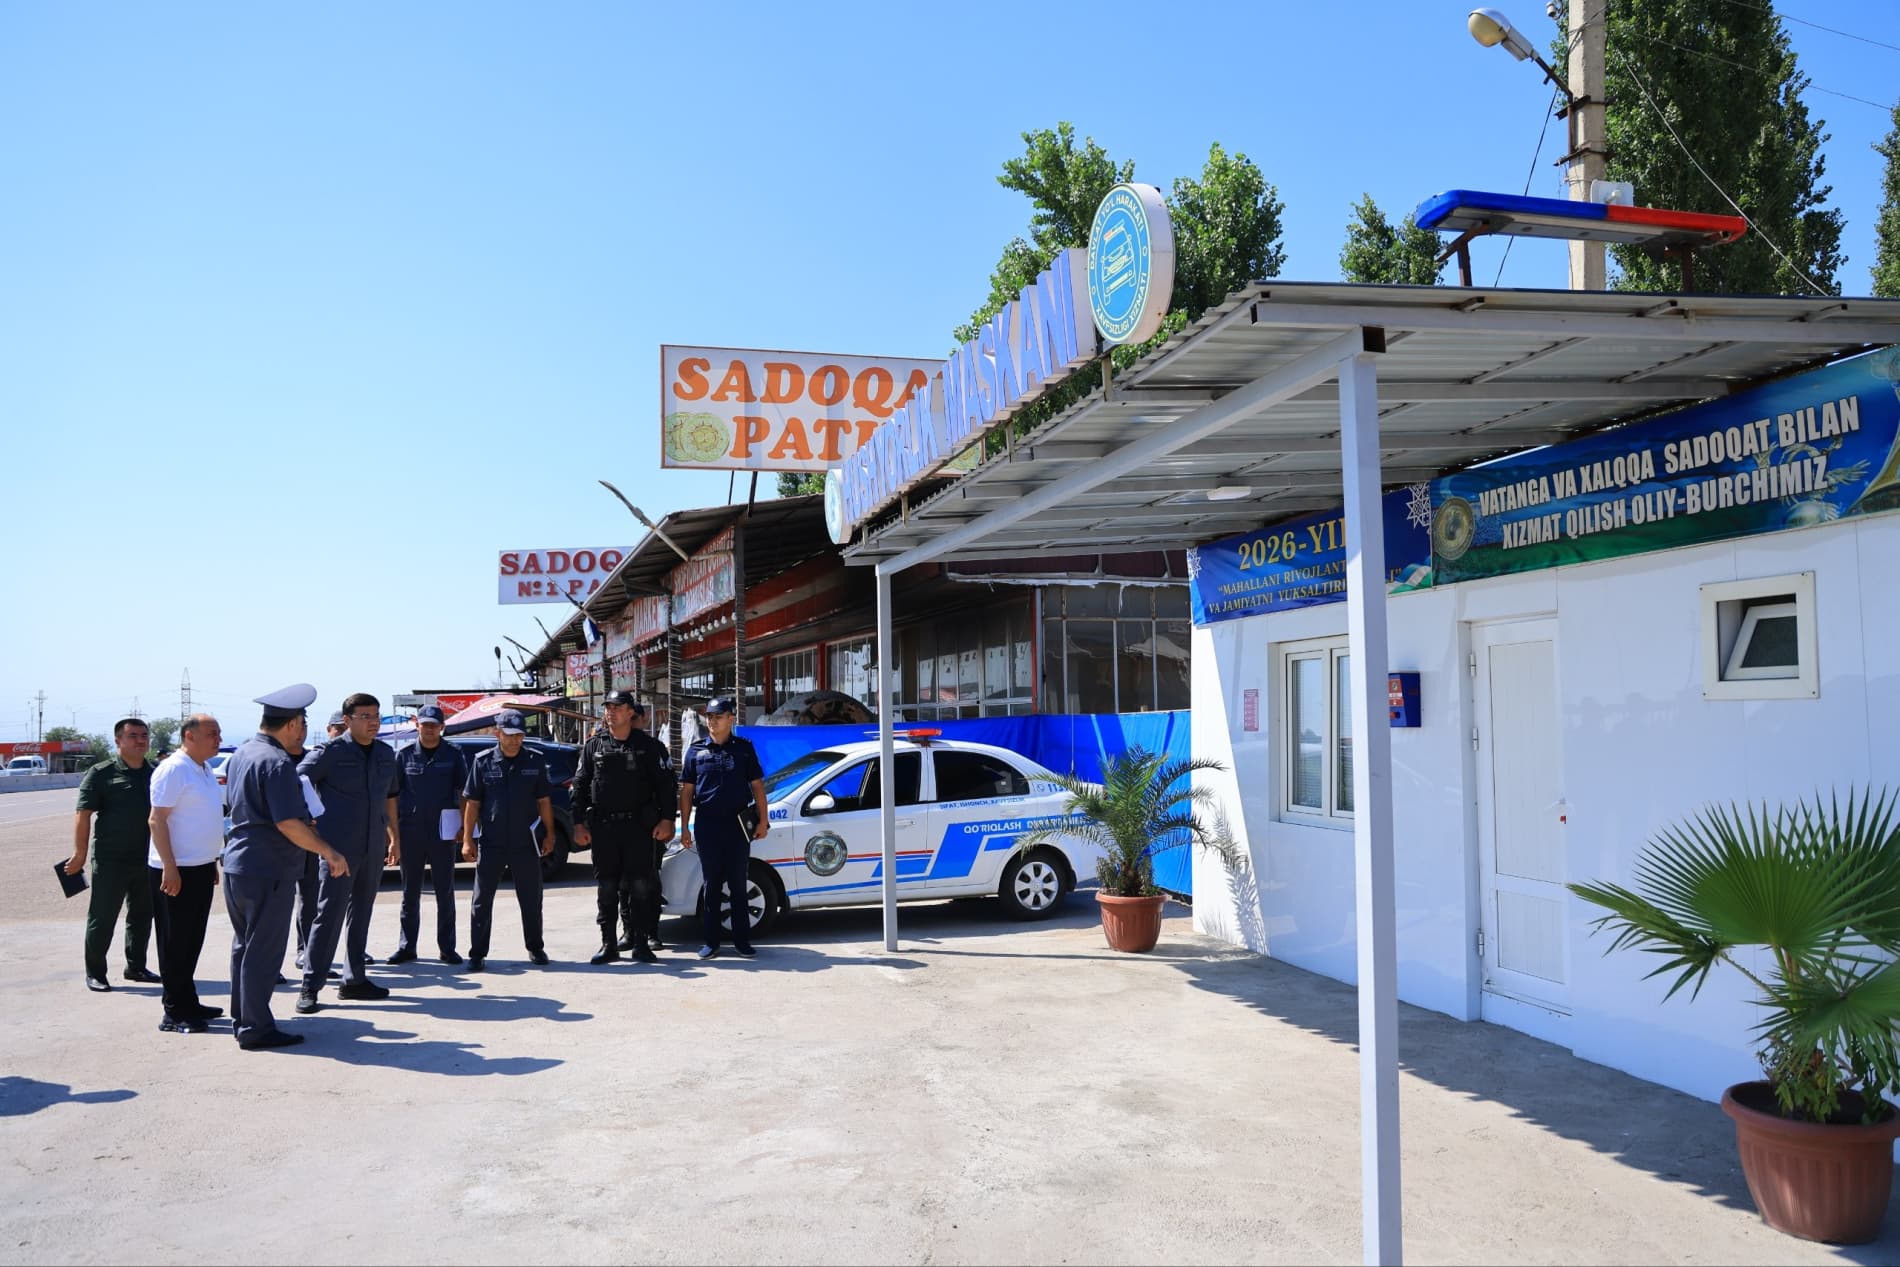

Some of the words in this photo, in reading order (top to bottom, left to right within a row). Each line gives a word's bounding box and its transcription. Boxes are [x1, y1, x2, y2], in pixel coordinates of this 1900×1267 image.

[1114, 193, 1145, 232] HARAKATI
[1129, 272, 1147, 323] XIZMATI
[943, 250, 1078, 447] MASKANI
[672, 357, 943, 418] SADOQA
[729, 415, 886, 461] PATI
[1479, 474, 1549, 517] VATANGA
[1552, 471, 1576, 501] VA
[1580, 449, 1655, 493] XALQQA
[1664, 419, 1770, 472] SADOQAT
[1777, 396, 1859, 447] BILAN
[1502, 512, 1561, 550] XIZMAT
[1566, 497, 1626, 540] QILISH
[1632, 455, 1829, 524] OLIY-BURCHIMIZ
[500, 550, 623, 575] SADOQ
[1238, 517, 1346, 570] 2026-YI
[568, 578, 601, 595] PA
[1284, 560, 1346, 584] RIVOJLANT
[1209, 603, 1221, 614] VA
[1222, 592, 1274, 612] JAMIYATNI
[1278, 578, 1347, 602] YUKSALTIRI
[769, 808, 788, 820] 042
